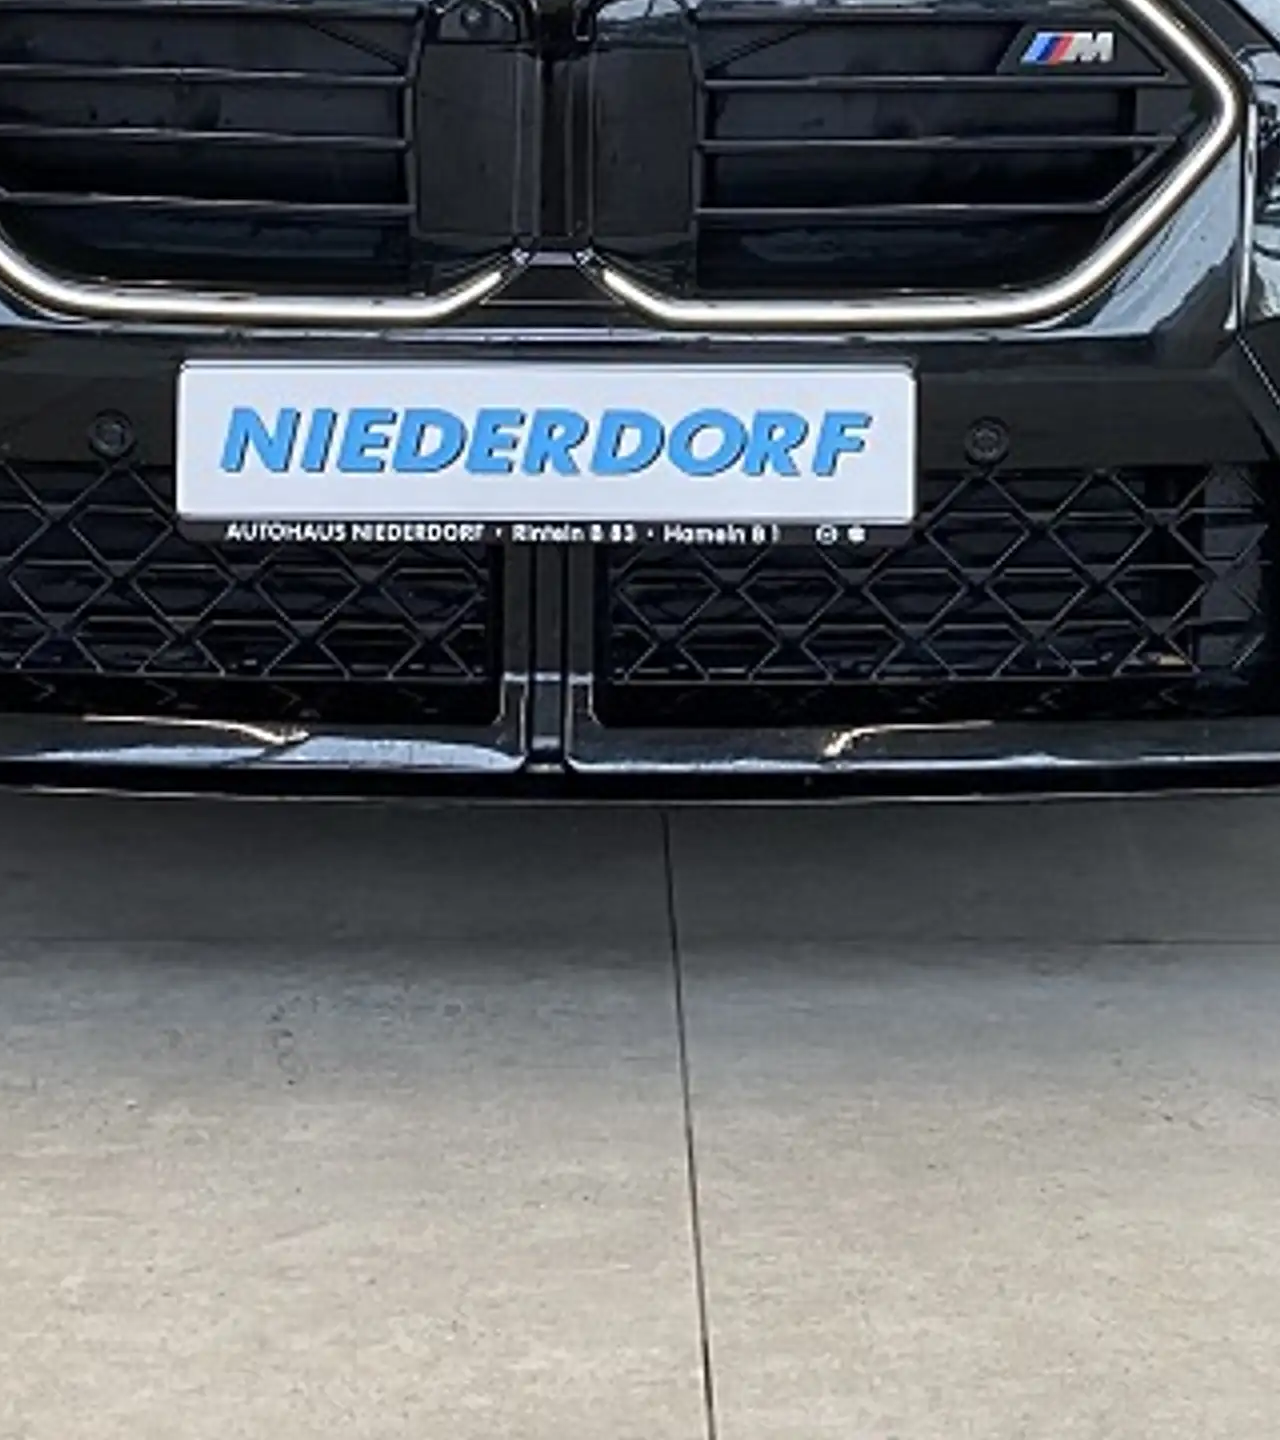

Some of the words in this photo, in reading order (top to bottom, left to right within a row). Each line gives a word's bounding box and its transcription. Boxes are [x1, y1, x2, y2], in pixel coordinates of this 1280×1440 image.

[222, 407, 872, 477] NIEDERDORF
[225, 523, 346, 542] AUTOHAUS
[351, 523, 485, 542] NIEDERDORF
[663, 524, 746, 544] Hameln
